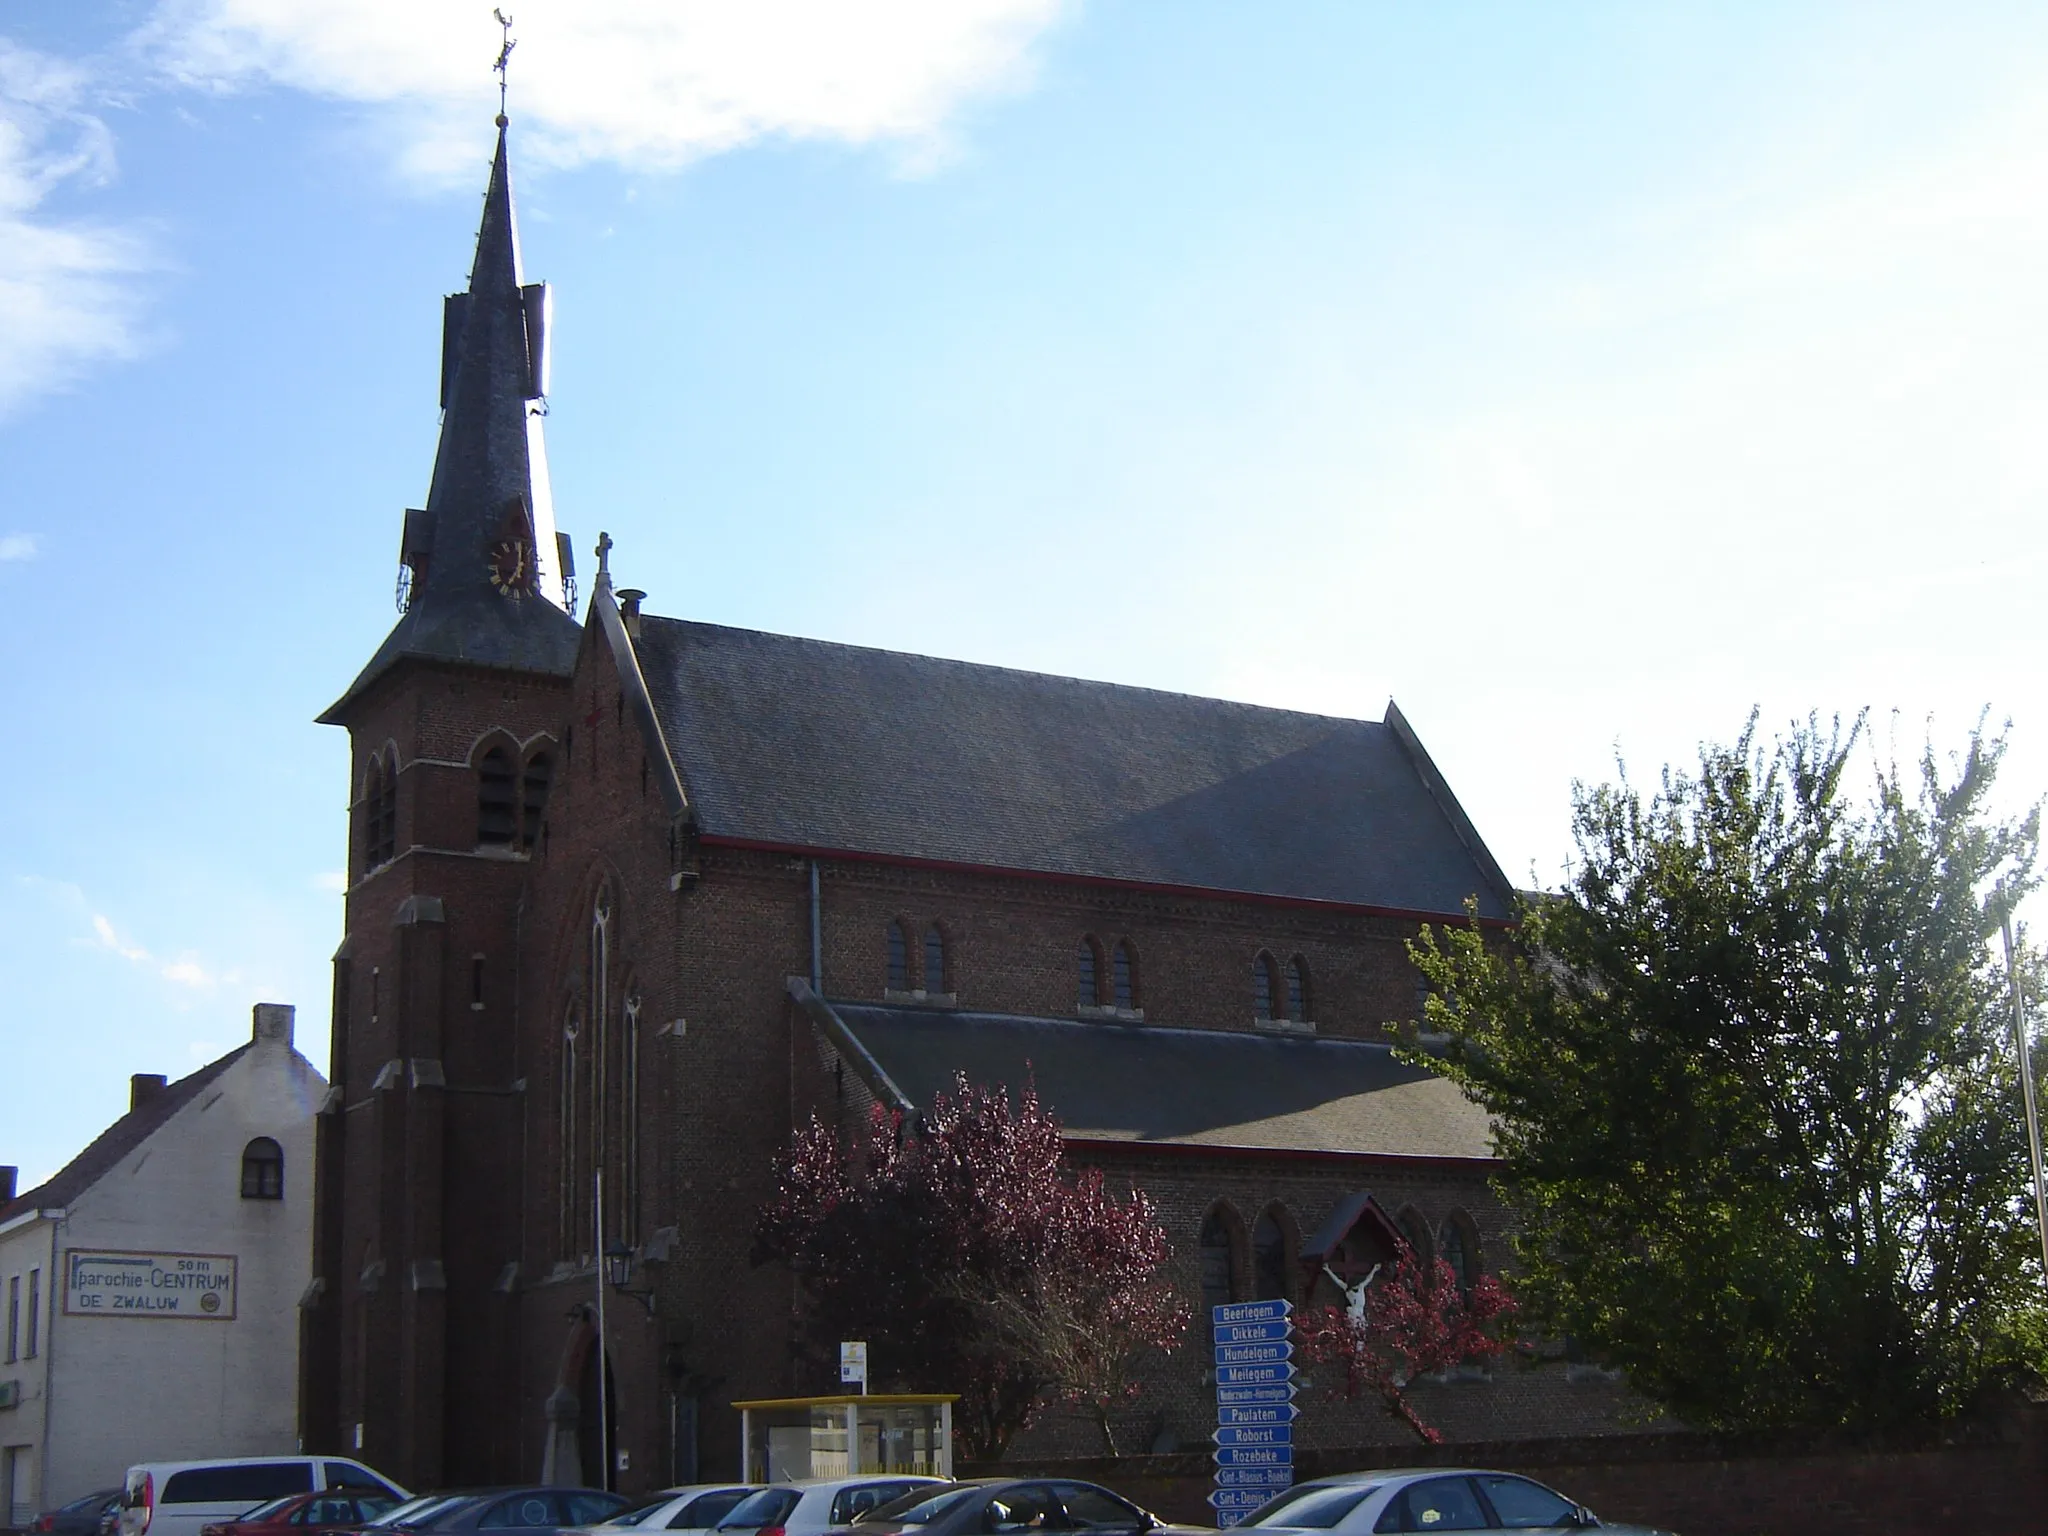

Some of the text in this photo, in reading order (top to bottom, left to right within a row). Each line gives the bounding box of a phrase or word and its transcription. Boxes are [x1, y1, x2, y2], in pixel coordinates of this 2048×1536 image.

[80, 1294, 179, 1310] DE ZWALUW
[1223, 1306, 1274, 1321] Beerlegem
[1232, 1325, 1267, 1340] Dikkele
[1224, 1347, 1277, 1362] Hundelgem
[1229, 1367, 1275, 1382] Meilegem
[1231, 1408, 1277, 1422] Paulatem
[1236, 1428, 1273, 1441] Roborst
[1232, 1449, 1278, 1463] Rozebeke
